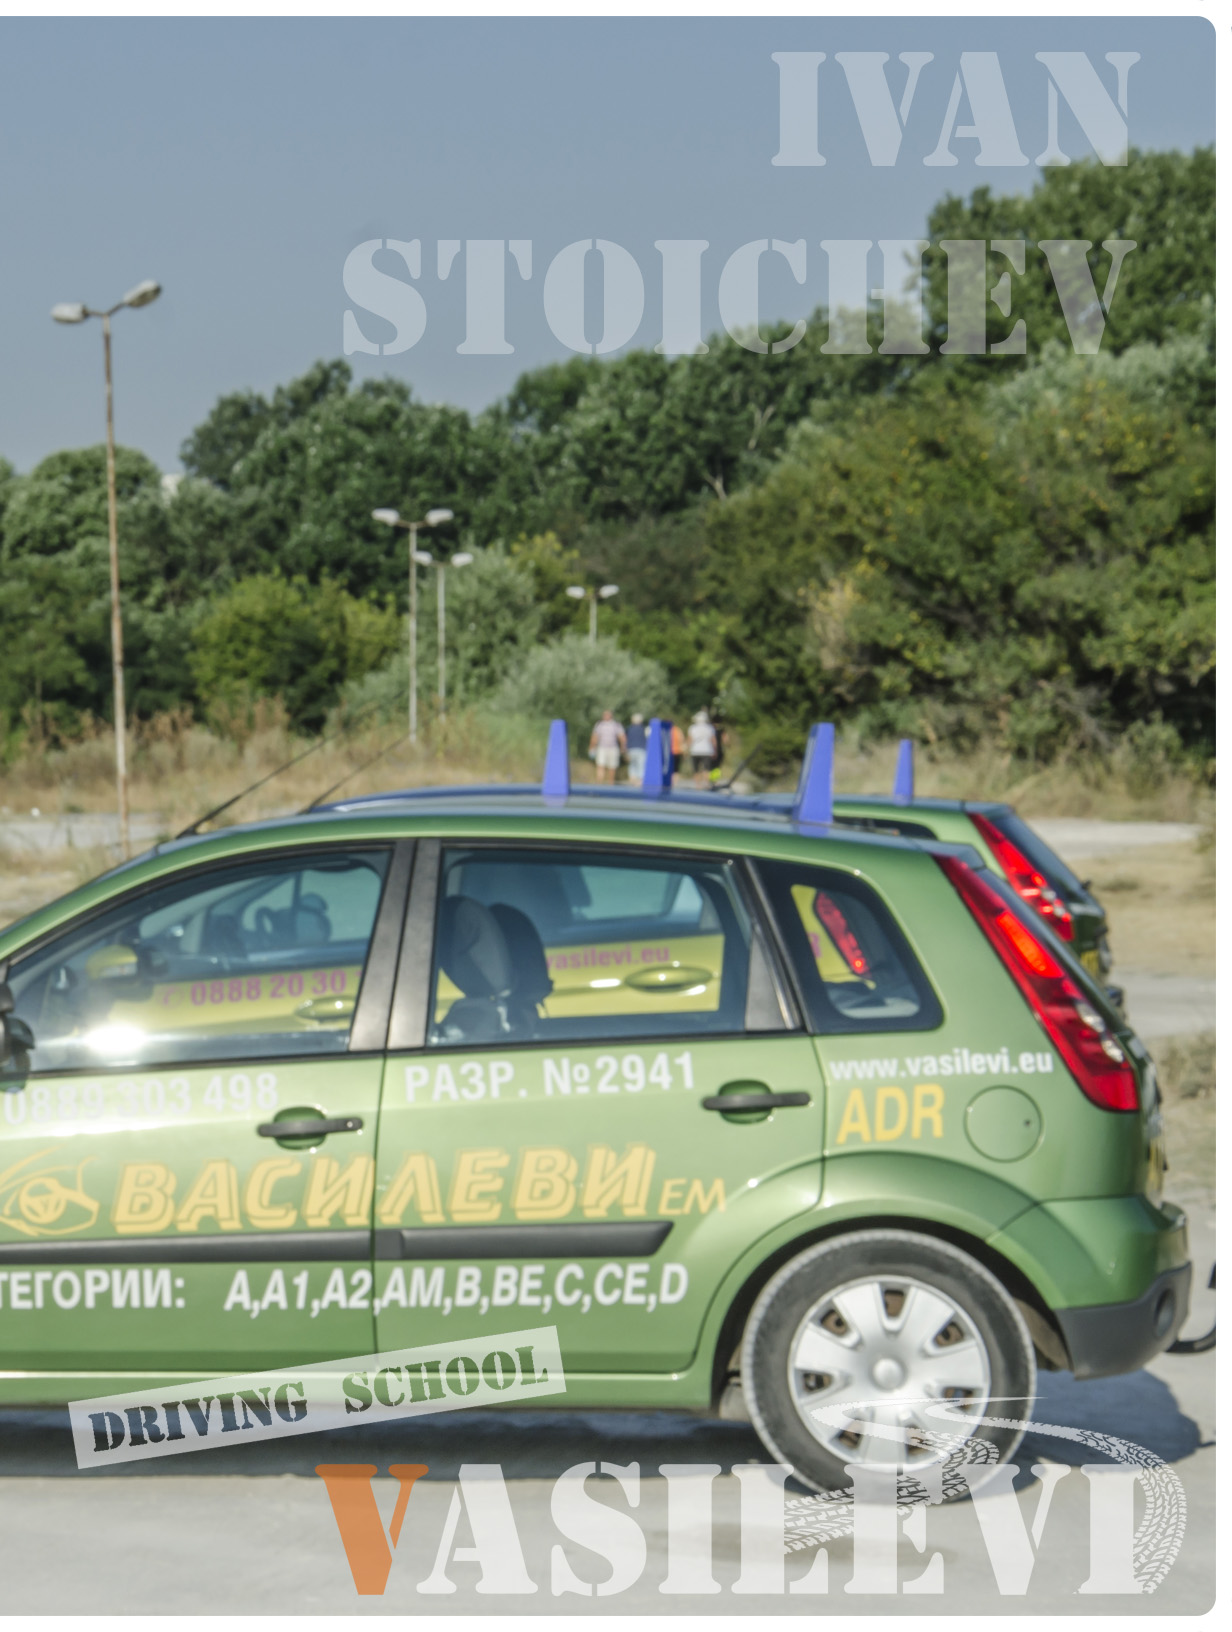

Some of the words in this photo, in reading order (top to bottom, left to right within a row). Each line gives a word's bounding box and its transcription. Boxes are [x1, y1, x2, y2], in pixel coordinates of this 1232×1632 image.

[189, 977, 262, 1006] 0888
[270, 973, 305, 999] 20
[311, 969, 347, 995] 30
[404, 1061, 528, 1101] РАЗР.
[828, 1046, 1054, 1081] www.vasilevi.eu
[3, 1083, 105, 1126] 0889
[203, 1072, 279, 1113] 498
[835, 1083, 945, 1145] ADR
[110, 1143, 657, 1234] ВАСИЛЕВИ
